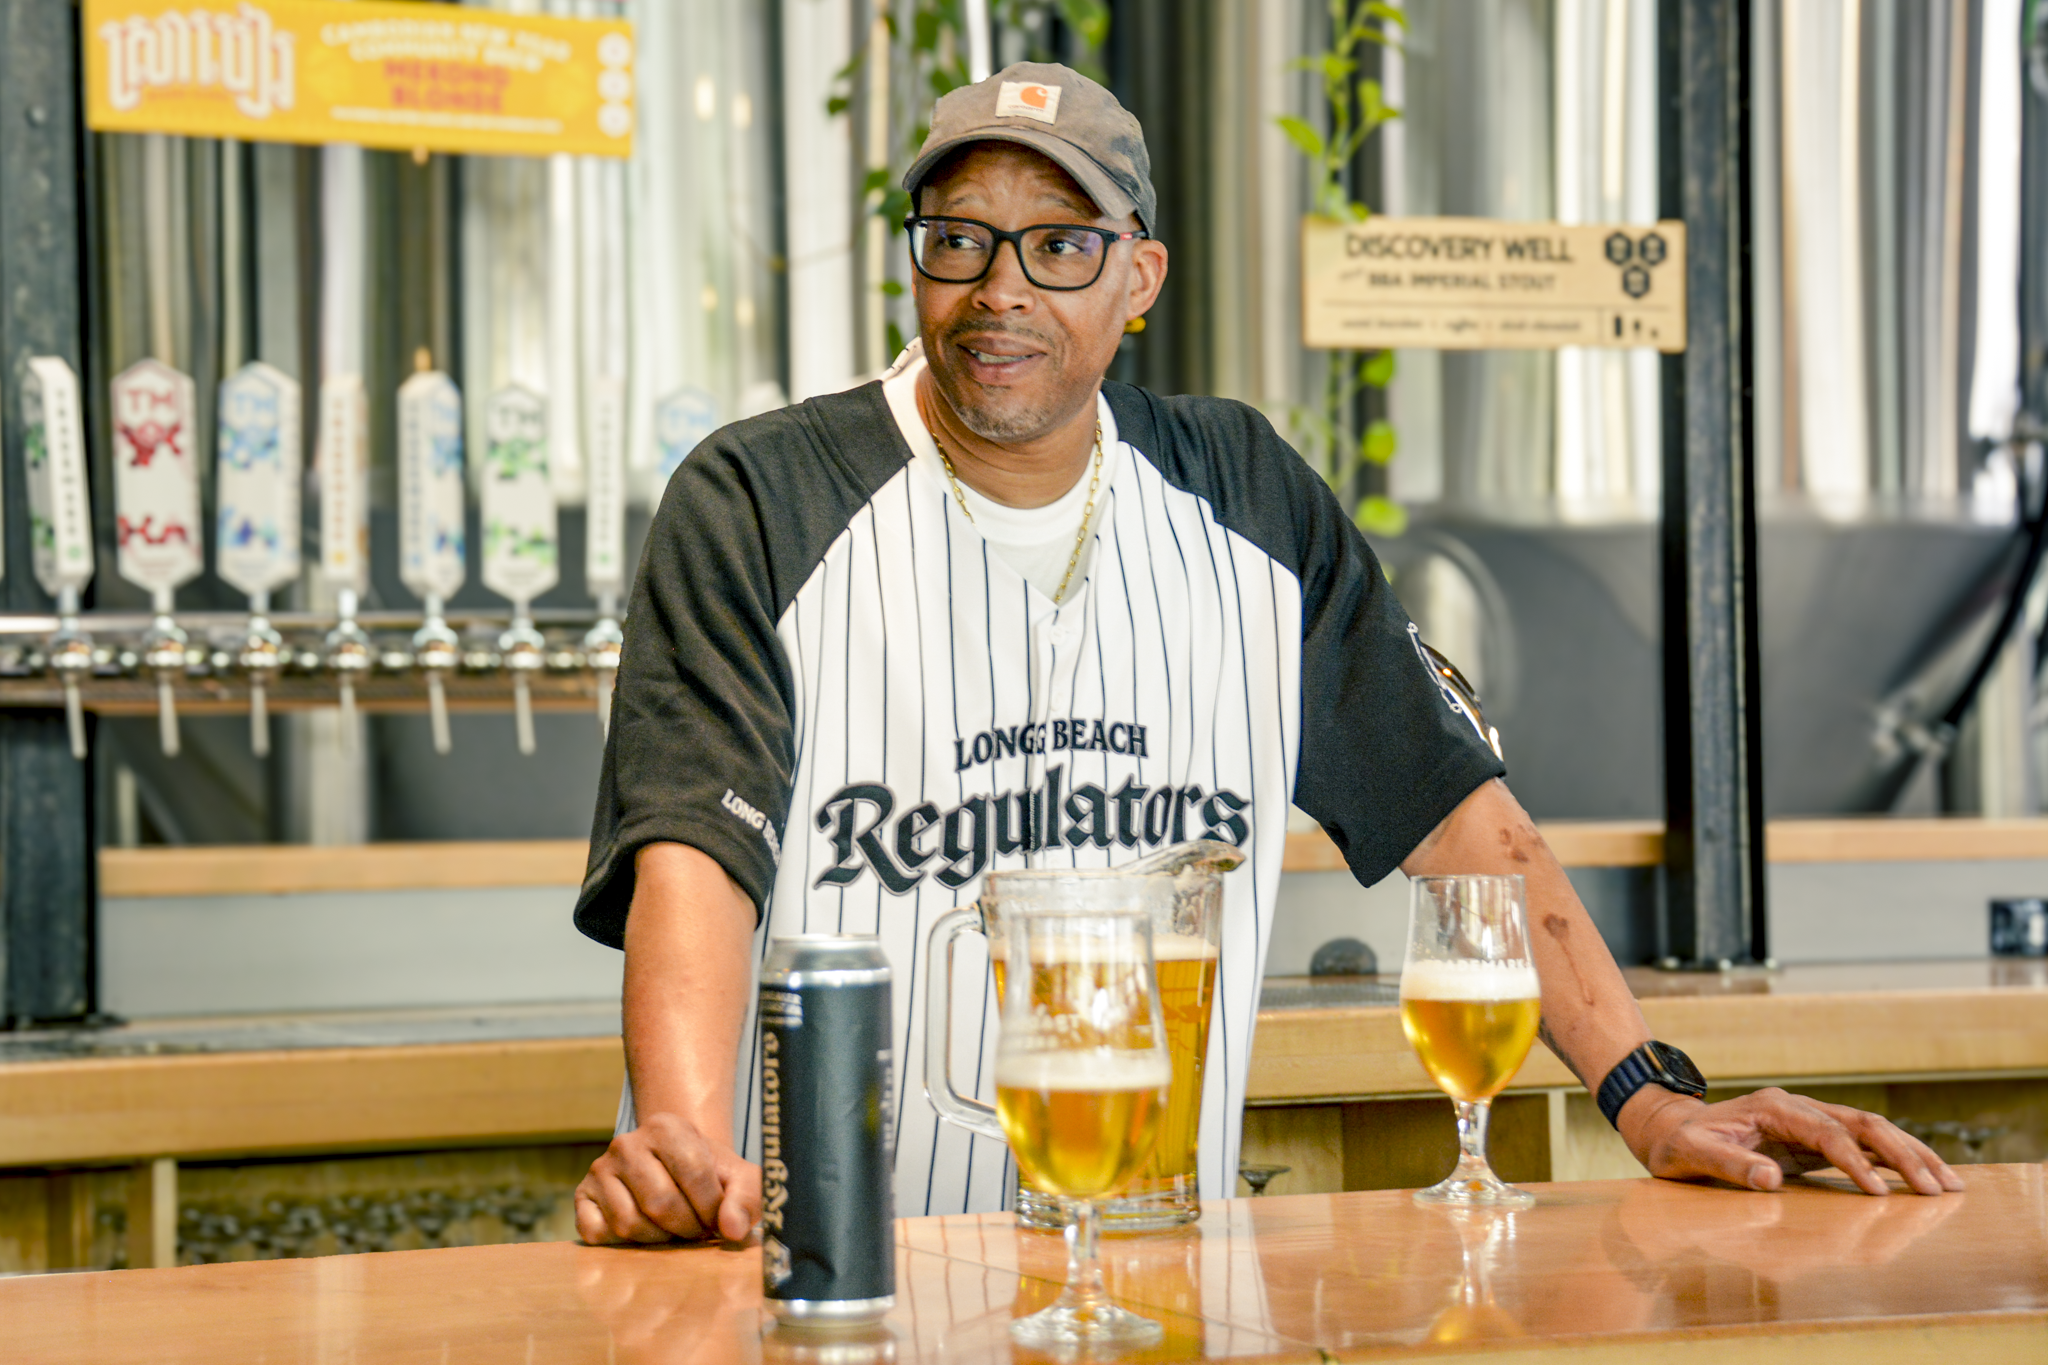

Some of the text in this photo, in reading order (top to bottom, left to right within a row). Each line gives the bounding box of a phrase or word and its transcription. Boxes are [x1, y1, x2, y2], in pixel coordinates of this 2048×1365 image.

[1346, 233, 1574, 263] DISCOVERY WELL
[1411, 271, 1491, 291] IMPERIAL
[1499, 273, 1556, 291] STOUT
[1052, 717, 1149, 758] BEACH
[721, 788, 766, 830] LONG
[813, 763, 1252, 896] Regulators
